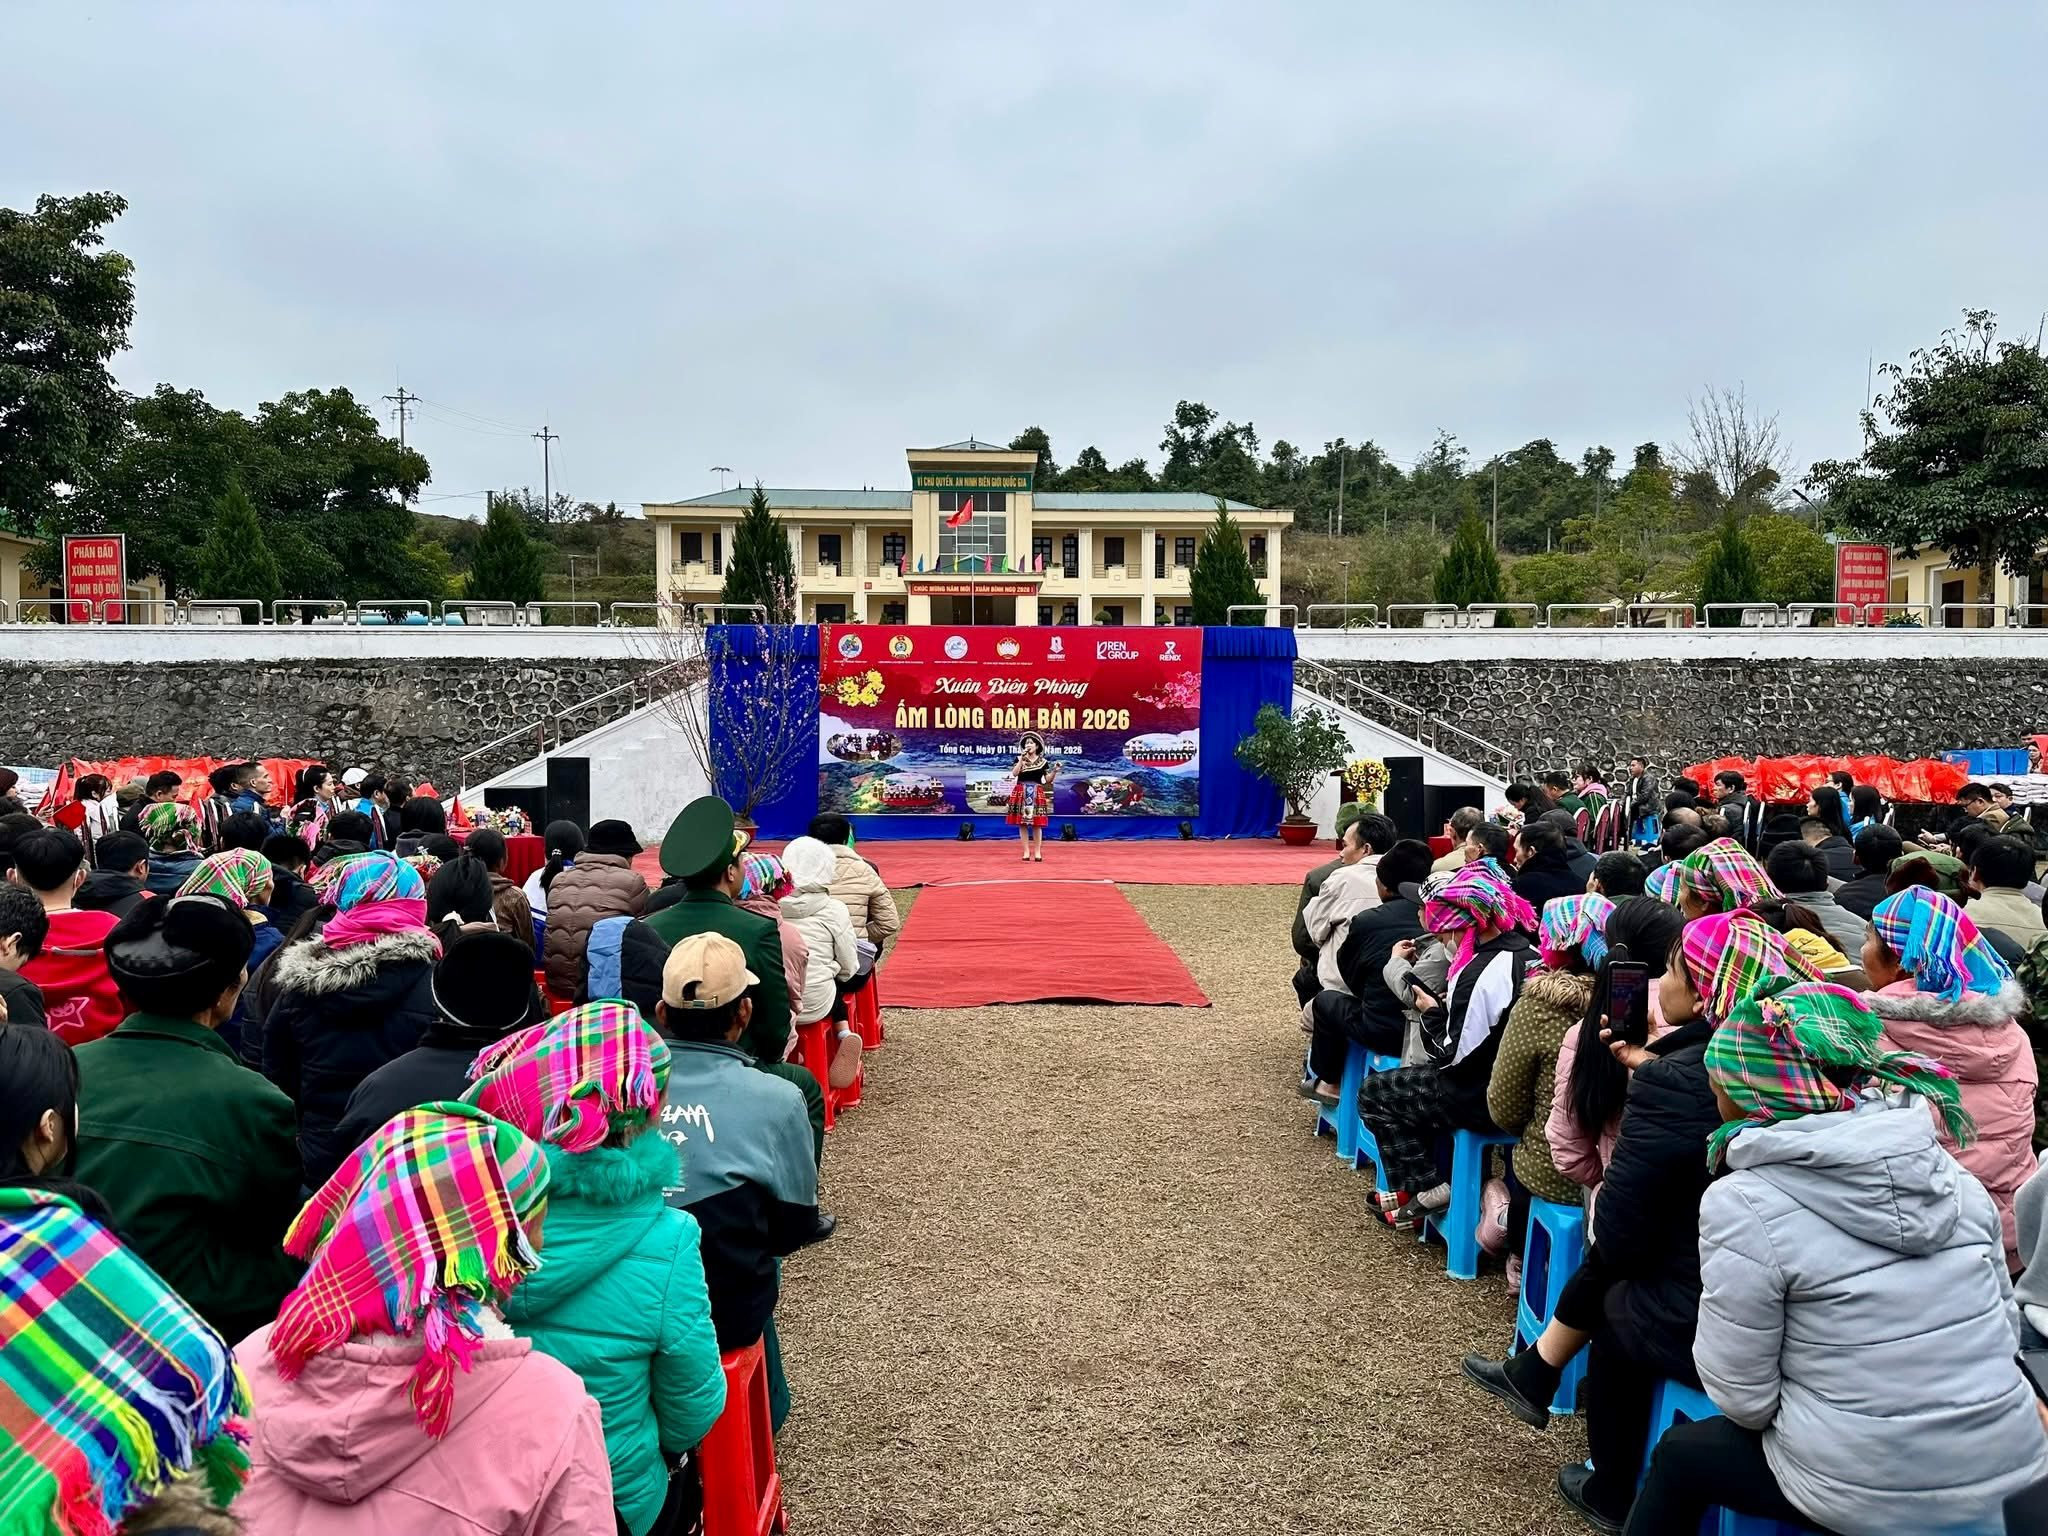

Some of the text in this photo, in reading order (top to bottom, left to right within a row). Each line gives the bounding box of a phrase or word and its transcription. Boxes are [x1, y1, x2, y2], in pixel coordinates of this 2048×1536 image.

[73, 544, 96, 558] PHẤN
[72, 562, 117, 576] XỨNG DANH
[92, 580, 104, 597] BỘ
[1107, 641, 1127, 651] REN
[1108, 651, 1139, 660] GROUP
[1159, 654, 1182, 662] RENIX
[933, 676, 1090, 699] Xuân Biên Phòng
[895, 698, 1131, 730] ẤM LÒNG DÂN BẢN 2026
[939, 743, 958, 755] Tổng
[976, 745, 996, 756] Ngày
[997, 746, 1006, 754] 01
[1063, 746, 1083, 755] 2026
